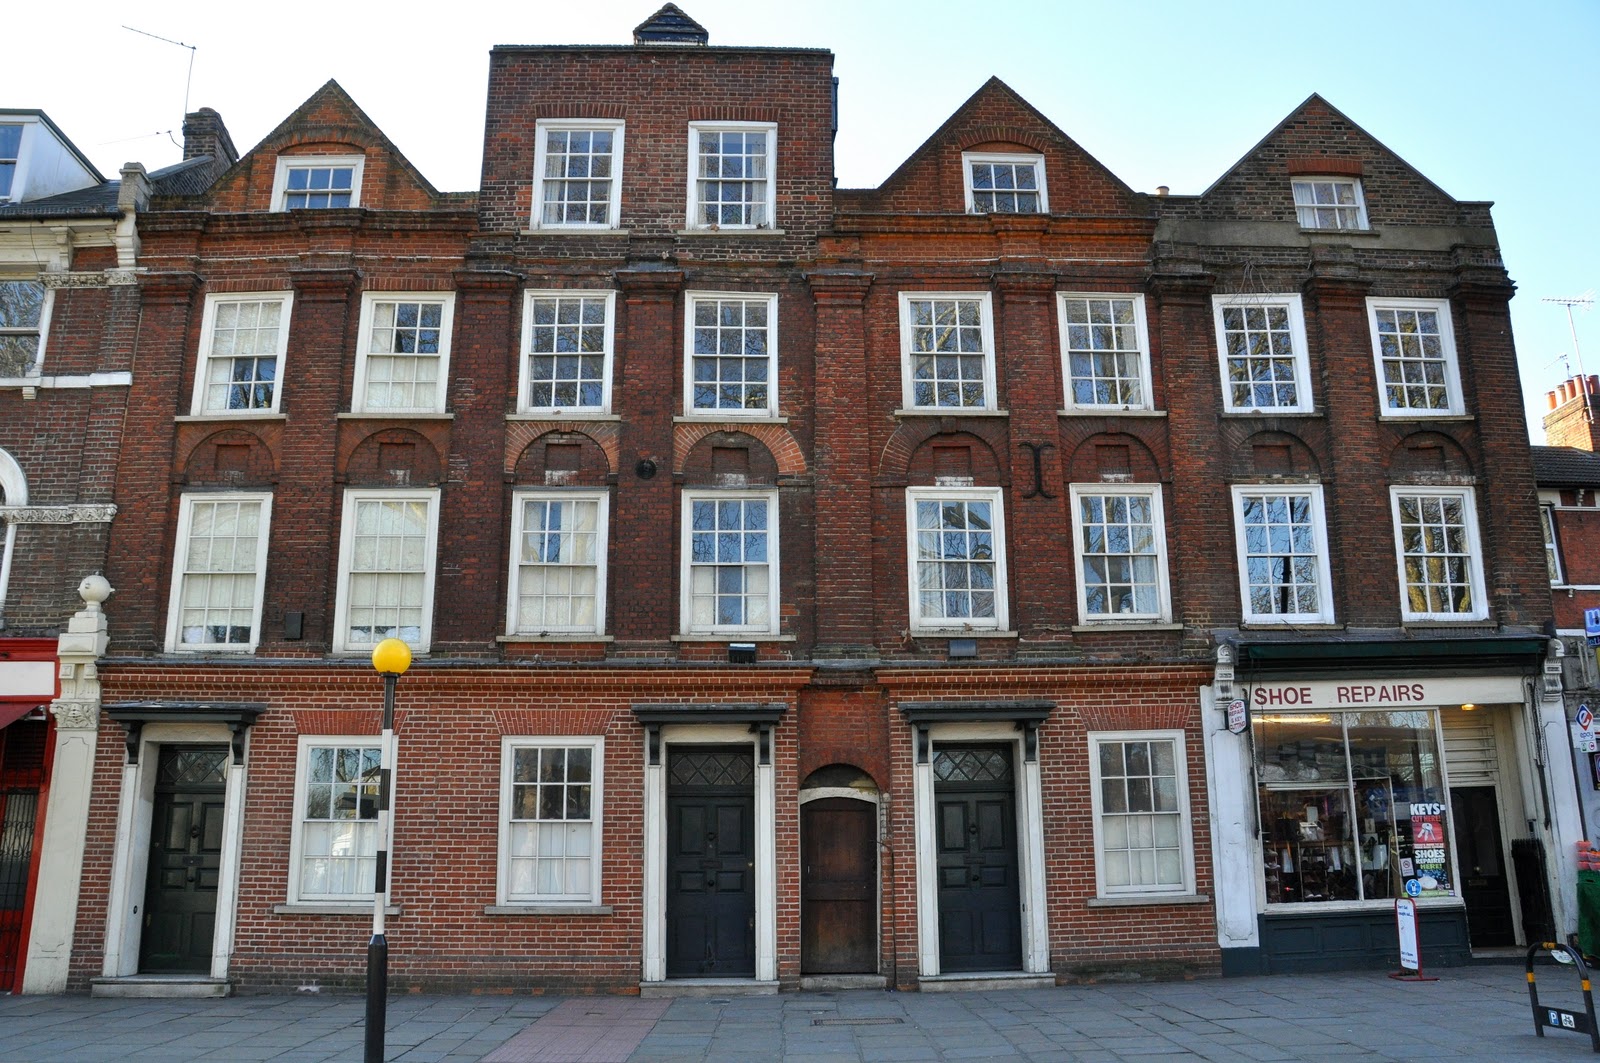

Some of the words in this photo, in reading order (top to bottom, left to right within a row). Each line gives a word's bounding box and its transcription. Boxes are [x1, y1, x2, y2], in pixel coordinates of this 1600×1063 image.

[1254, 687, 1313, 705] SHOE
[1337, 684, 1425, 703] REPAIRS
[1230, 702, 1242, 710] SHOE
[1229, 708, 1244, 717] REPAIR
[1230, 721, 1246, 730] CUTTING
[1580, 731, 1594, 740] epay
[1410, 803, 1440, 815] KEYS
[1414, 849, 1445, 859] SHOES
[1550, 1012, 1557, 1024] P
